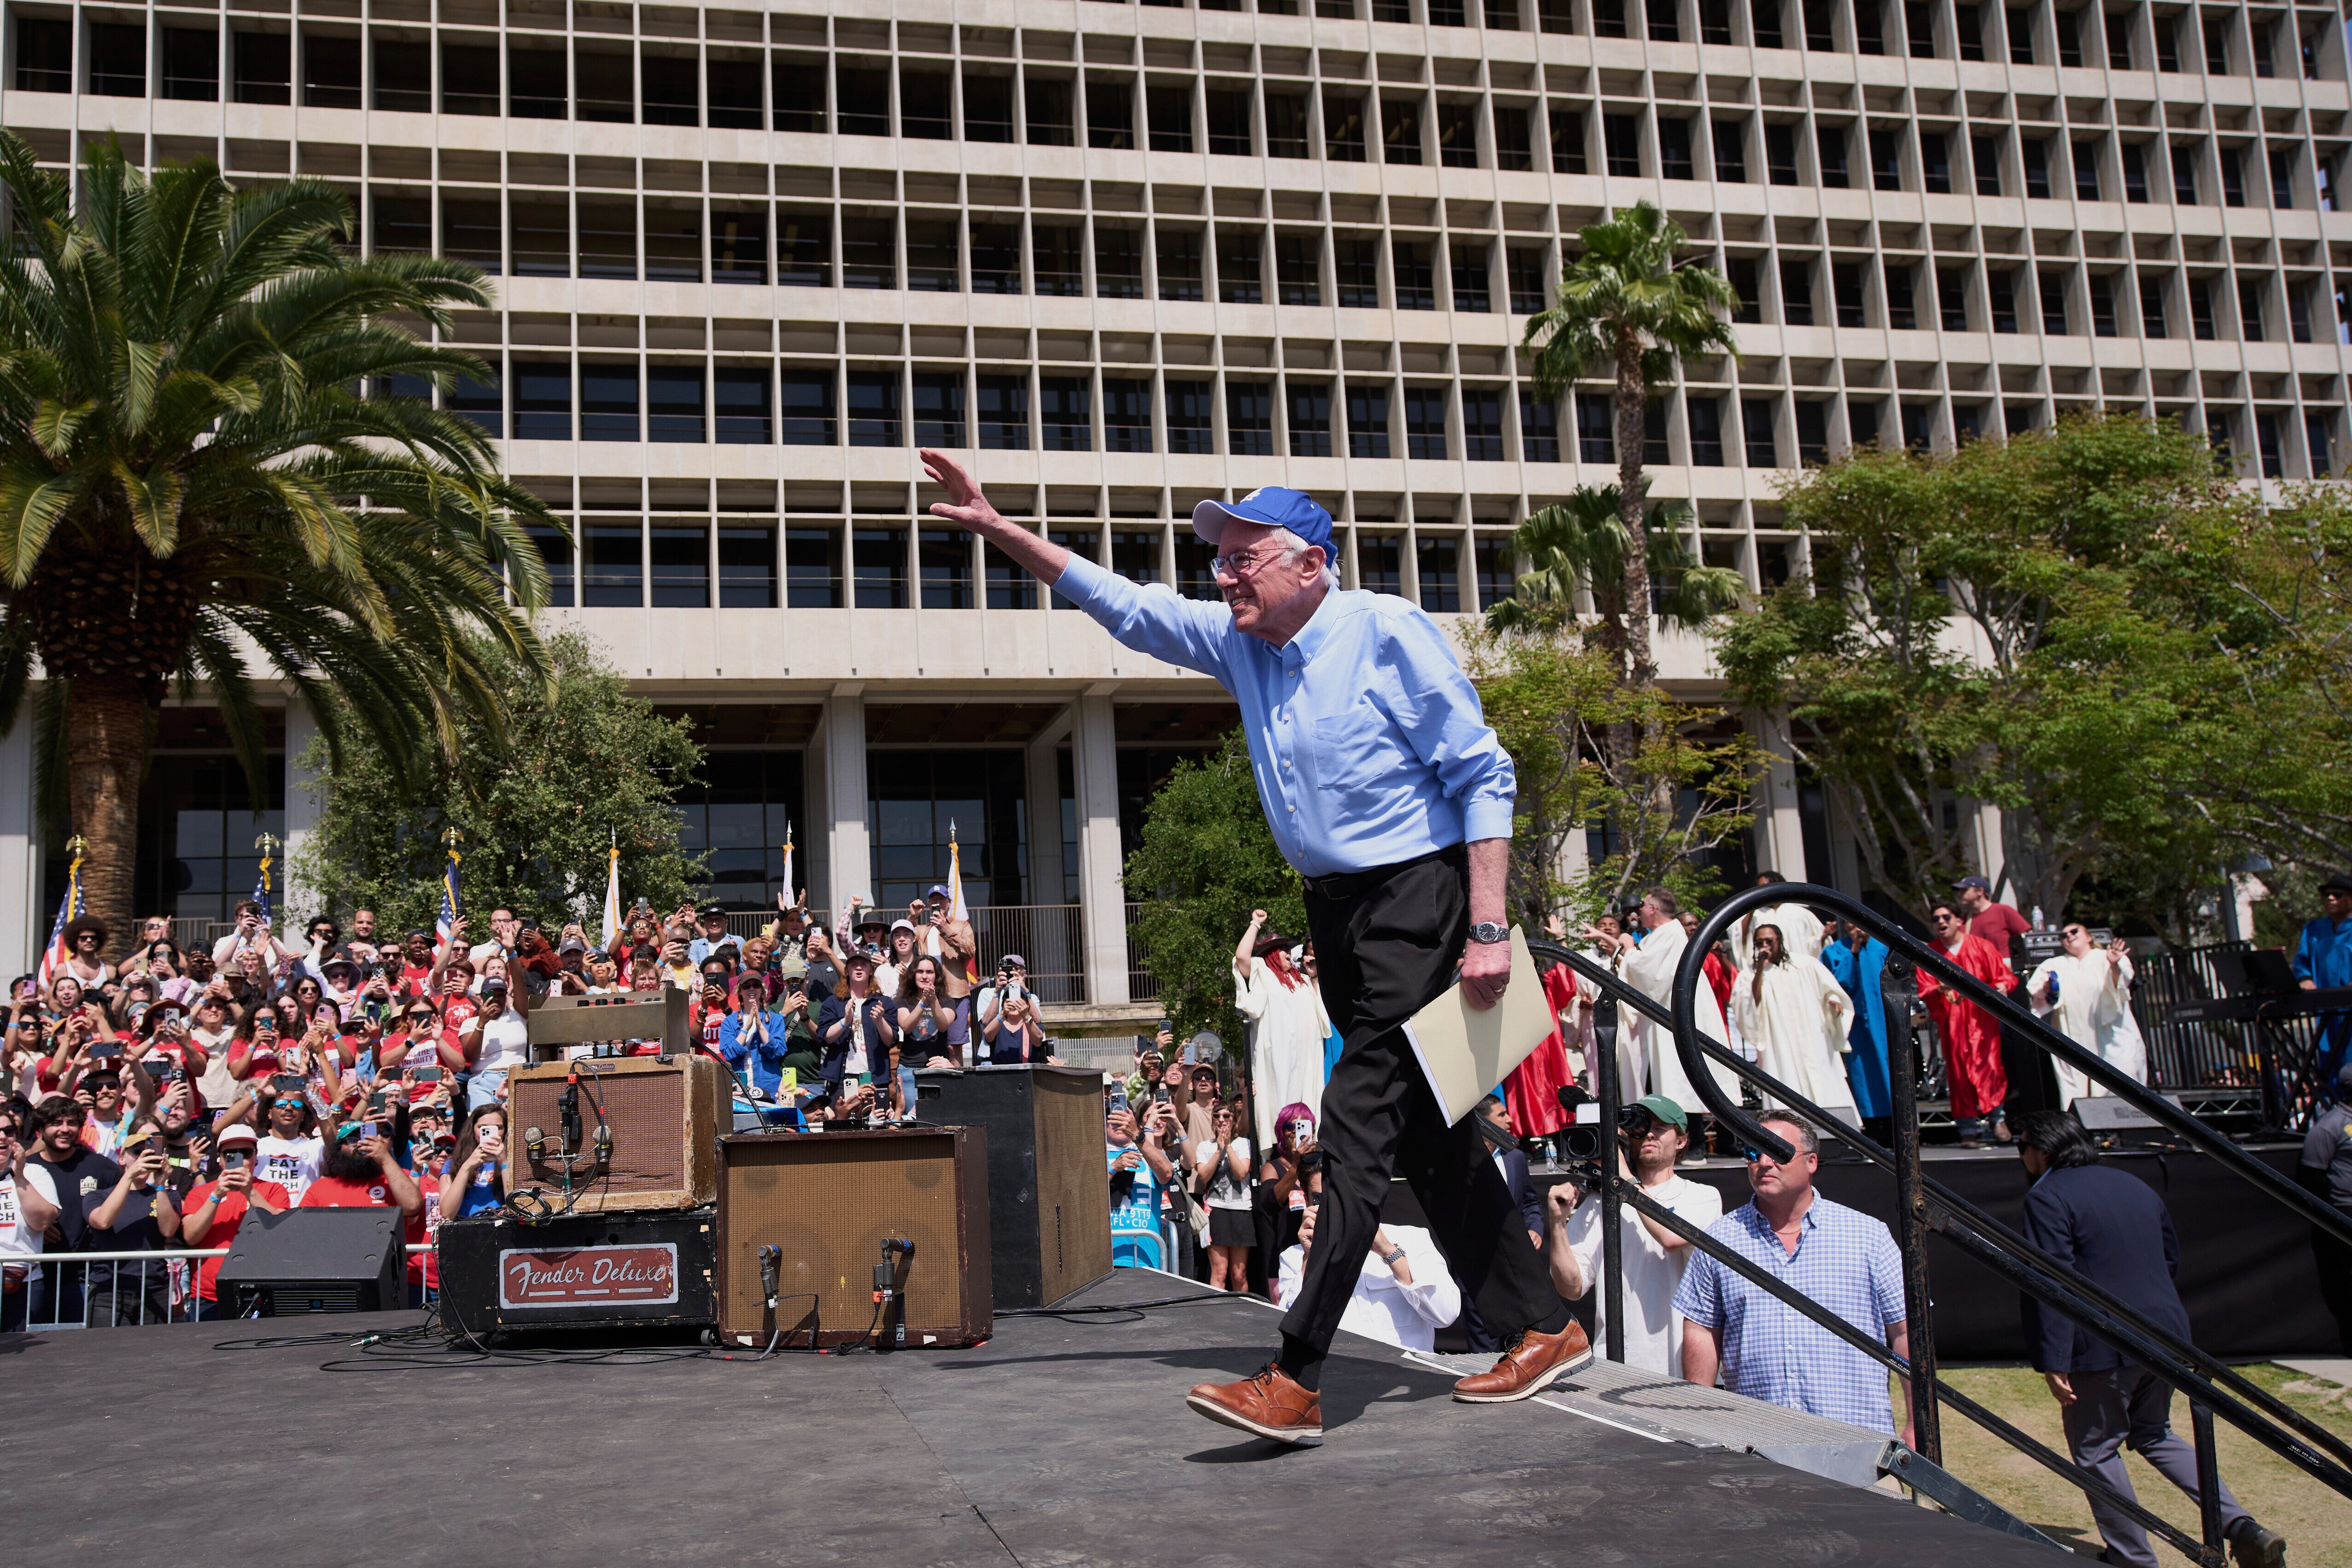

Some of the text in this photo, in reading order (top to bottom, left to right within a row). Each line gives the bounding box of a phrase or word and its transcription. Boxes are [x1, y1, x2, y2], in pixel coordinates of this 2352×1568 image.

[269, 1158, 298, 1167] EAT
[269, 1170, 298, 1179] THE
[1130, 1209, 1151, 1220] 9119
[509, 1258, 664, 1296] Fender Deluxe
